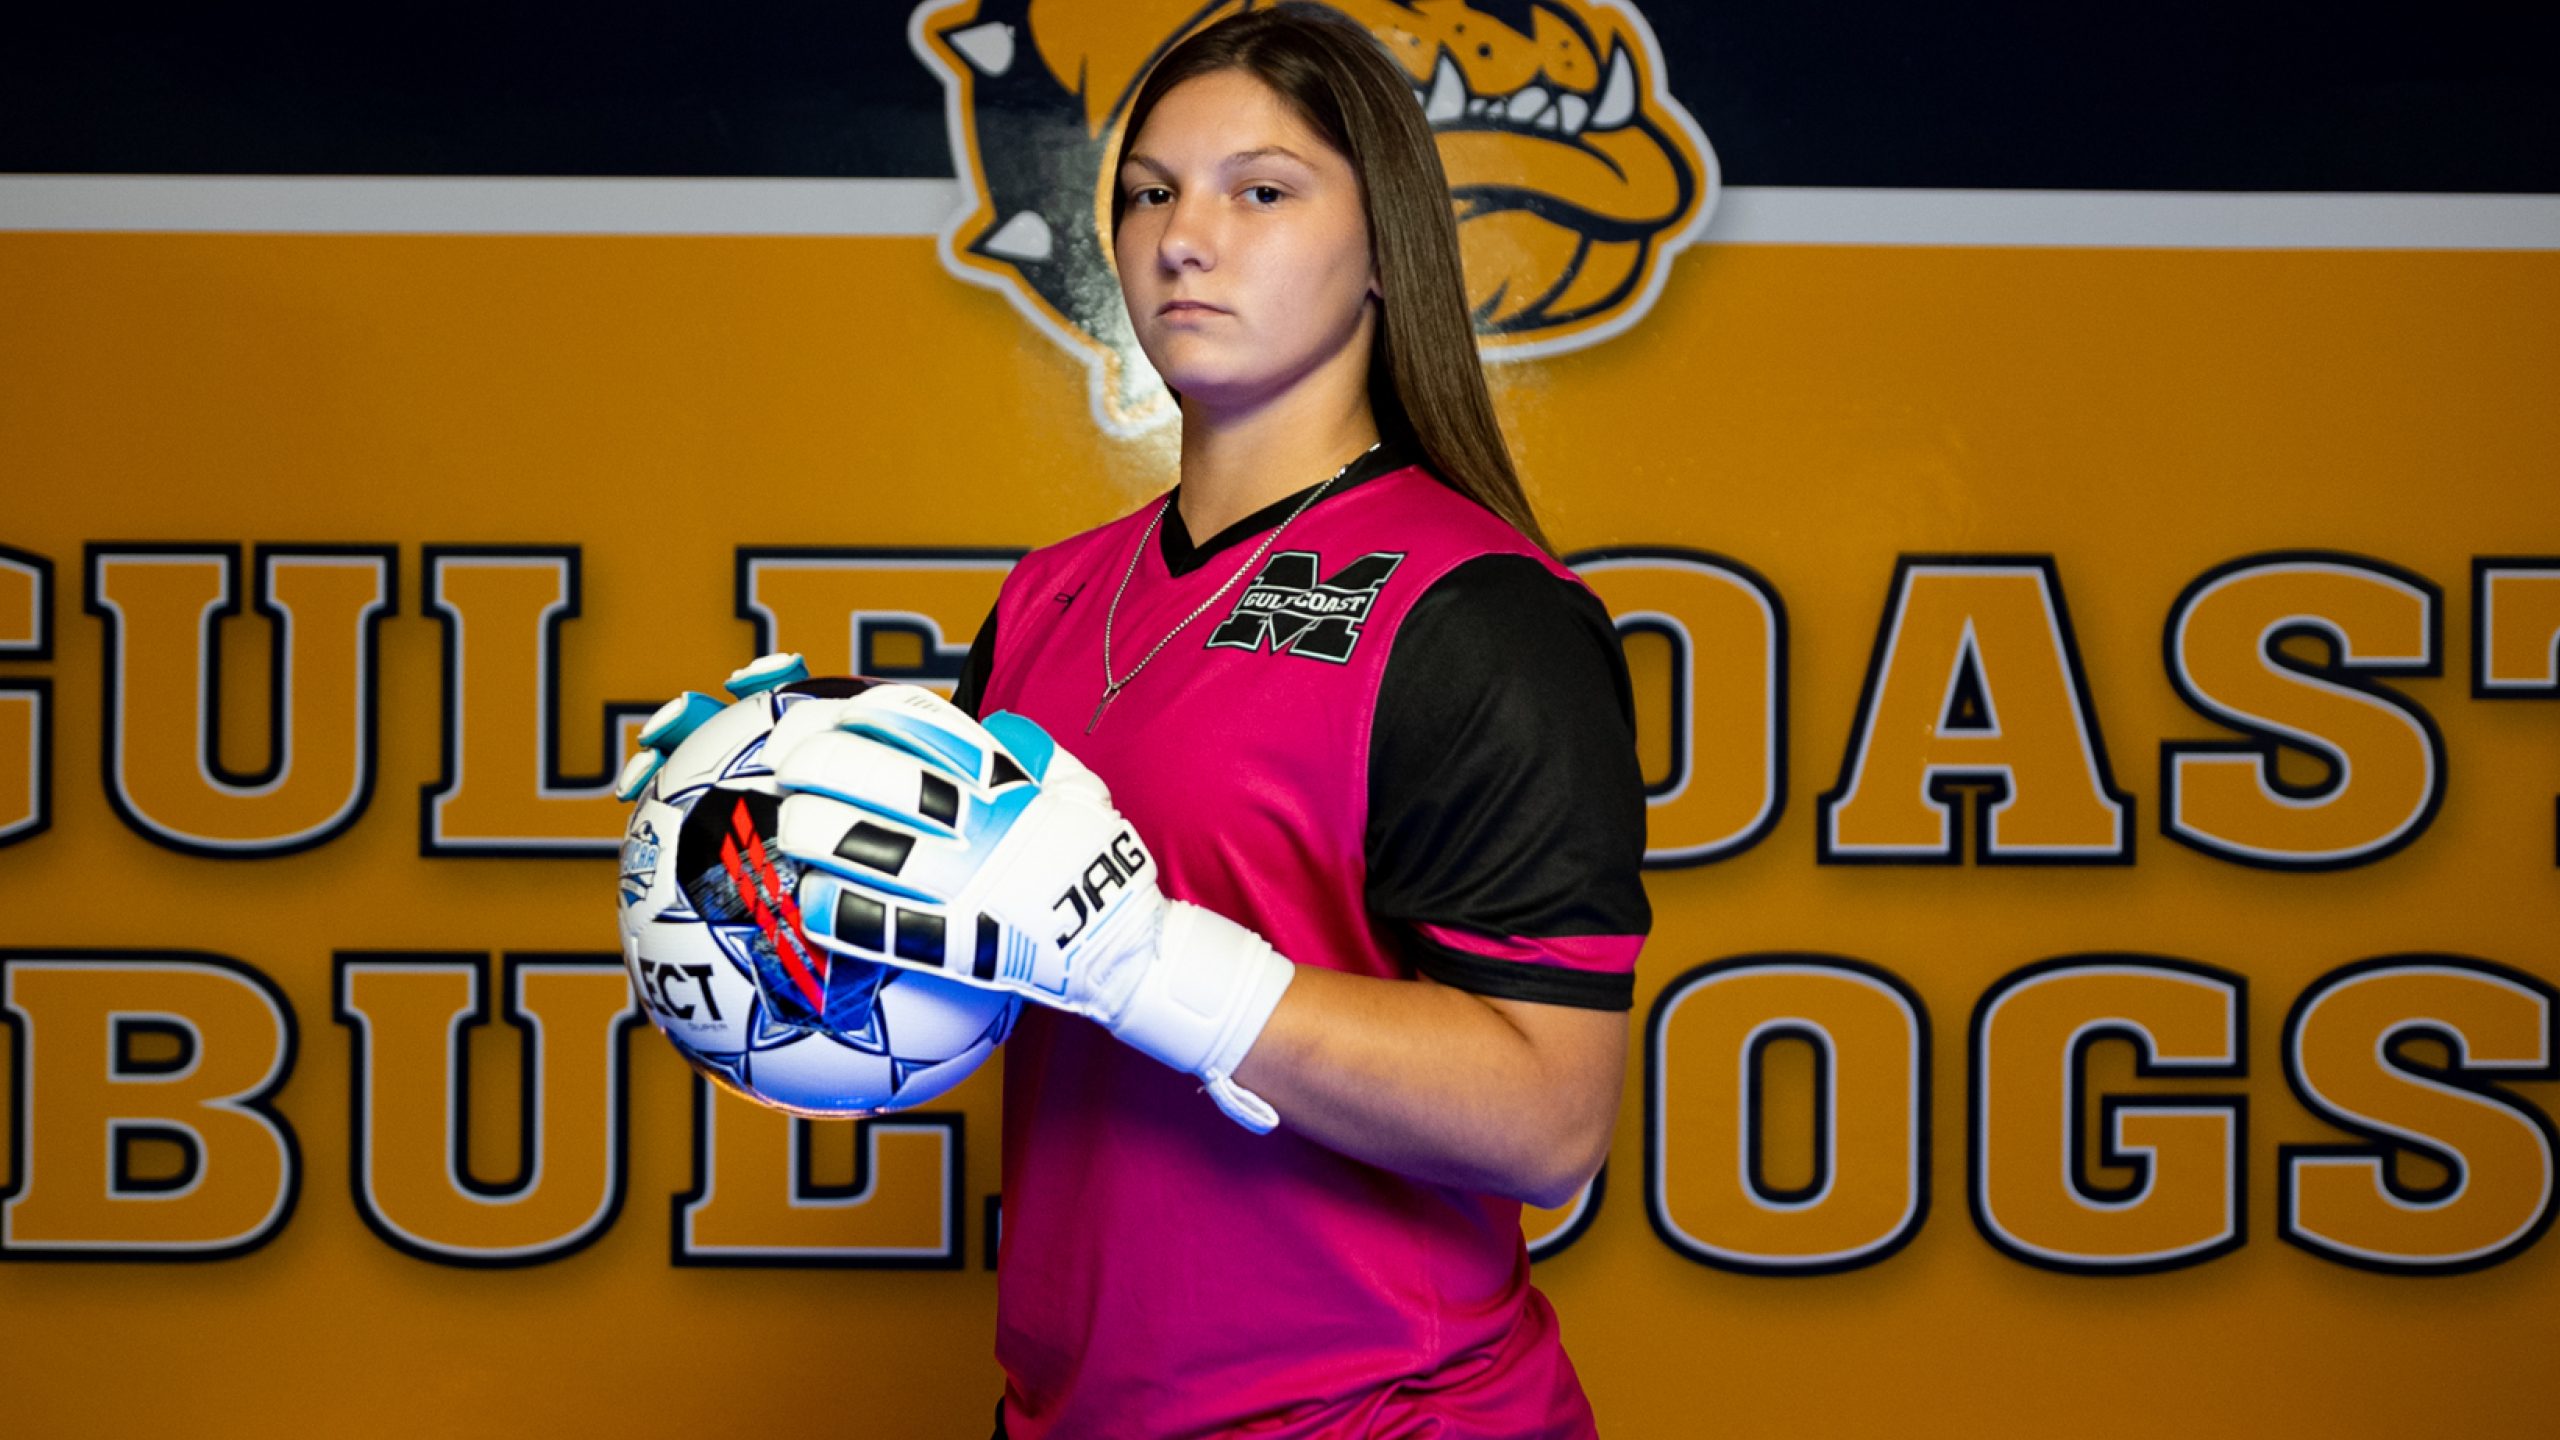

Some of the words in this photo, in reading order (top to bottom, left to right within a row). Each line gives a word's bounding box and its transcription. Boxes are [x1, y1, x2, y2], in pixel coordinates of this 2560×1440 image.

[1292, 591, 1367, 613] COAST
[1557, 547, 2560, 872] OAS
[1053, 830, 1146, 950] JAG
[639, 957, 722, 1021] ECT
